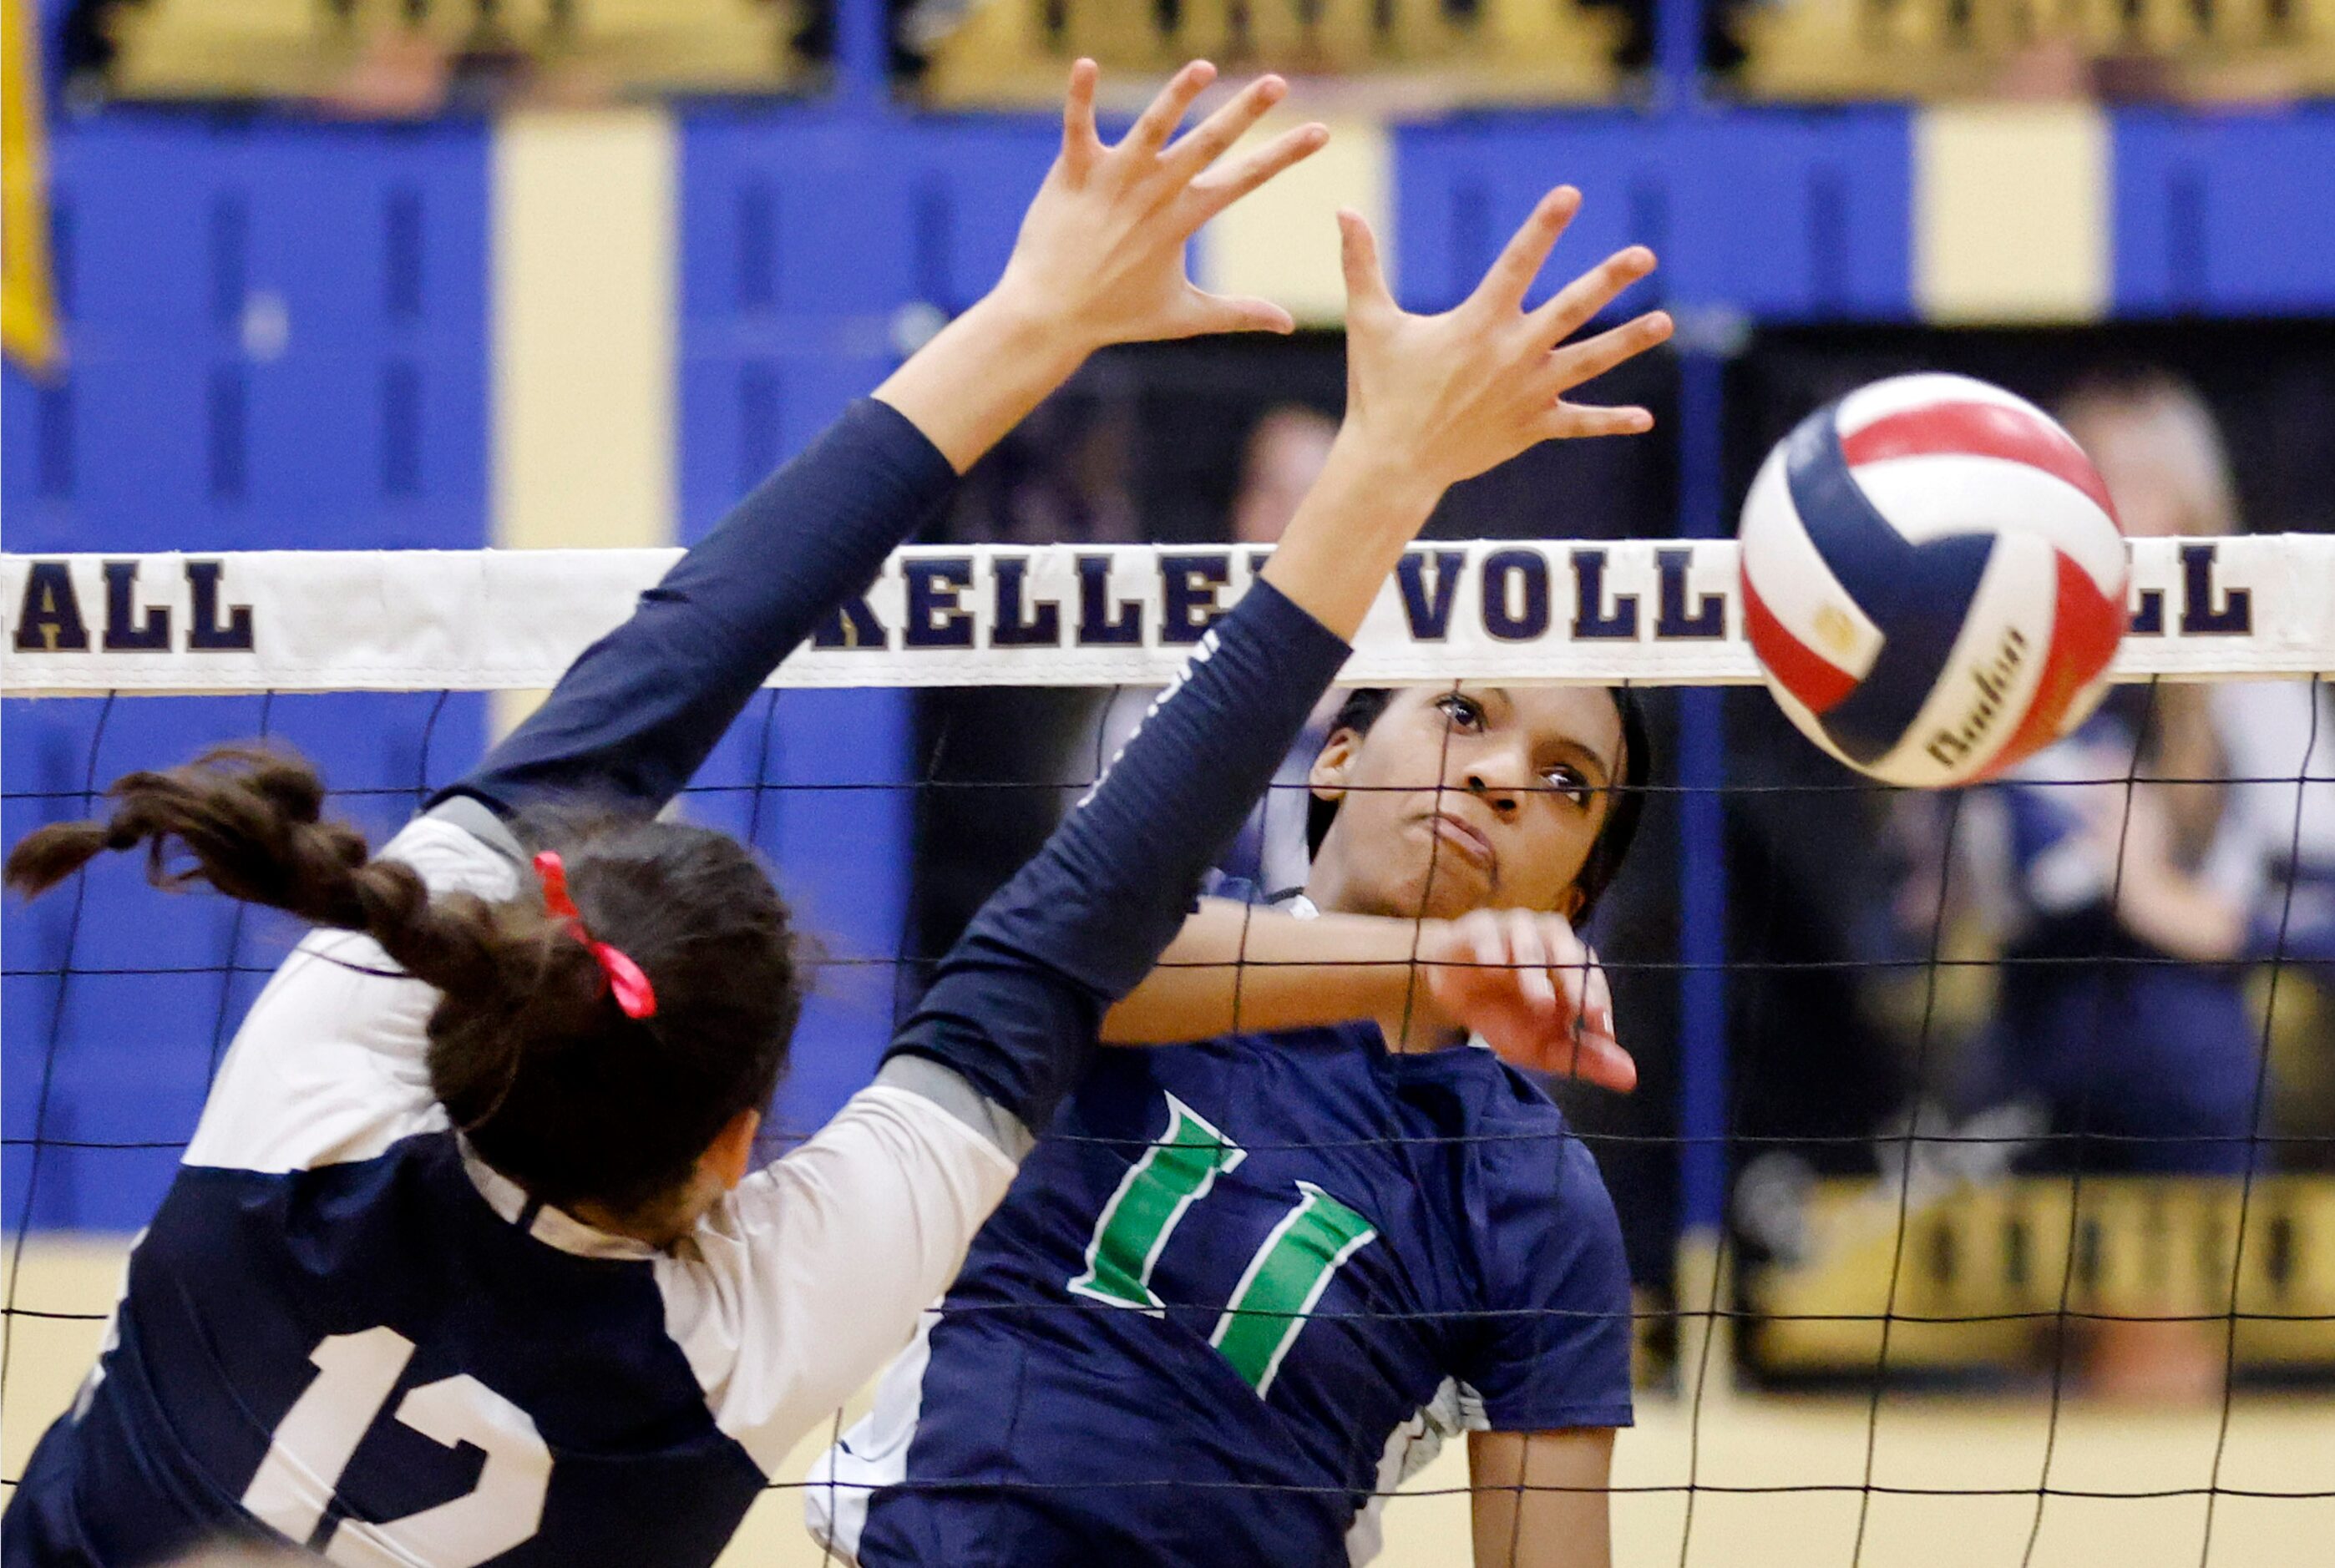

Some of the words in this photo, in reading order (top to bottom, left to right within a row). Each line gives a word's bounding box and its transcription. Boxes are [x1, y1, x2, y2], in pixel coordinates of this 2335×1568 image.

[810, 551, 1269, 651] KELLE
[1067, 1089, 1378, 1402] 11
[241, 1325, 555, 1568] 12
